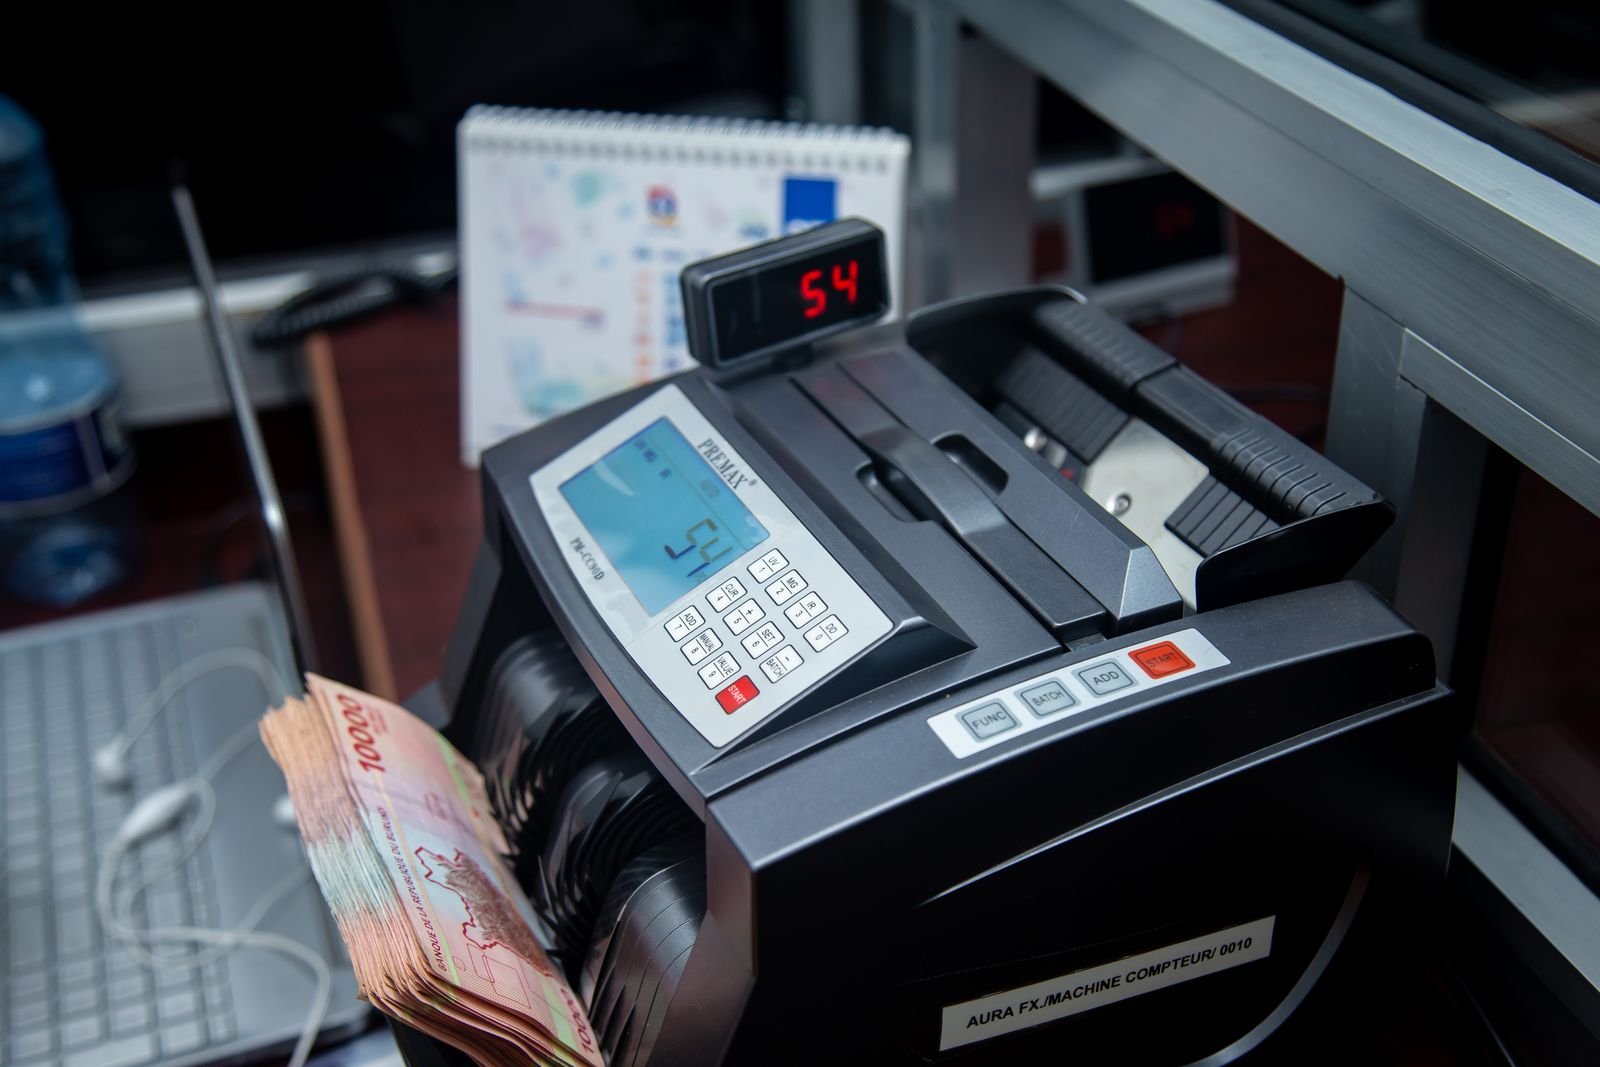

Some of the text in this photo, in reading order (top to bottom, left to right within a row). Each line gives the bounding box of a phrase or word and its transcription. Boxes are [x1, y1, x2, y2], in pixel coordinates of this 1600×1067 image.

[801, 260, 858, 318] 54
[697, 437, 748, 490] PREMAX
[664, 518, 733, 577] 54
[768, 556, 779, 566] UV
[725, 583, 739, 598] CUR
[776, 587, 785, 595] 2
[786, 577, 799, 589] MG
[806, 601, 817, 610] IR
[683, 613, 697, 627] ADD
[734, 617, 742, 625] 5
[795, 610, 803, 618] 3
[762, 629, 776, 642] SET
[825, 623, 837, 634] DD
[700, 634, 716, 652] MANUAL
[752, 640, 760, 648] 6
[717, 656, 734, 676] VALUE
[766, 659, 784, 677] BATCH
[1146, 652, 1178, 668] START
[1093, 670, 1120, 686] ADD
[728, 685, 746, 704] START
[1032, 690, 1065, 708] BATCH
[971, 710, 1007, 731] FUNC
[336, 694, 385, 772] 10000
[427, 931, 447, 972] BANQUE
[966, 937, 1252, 1029] AURA FX./MACHINE COMPTEUR/ 0010
